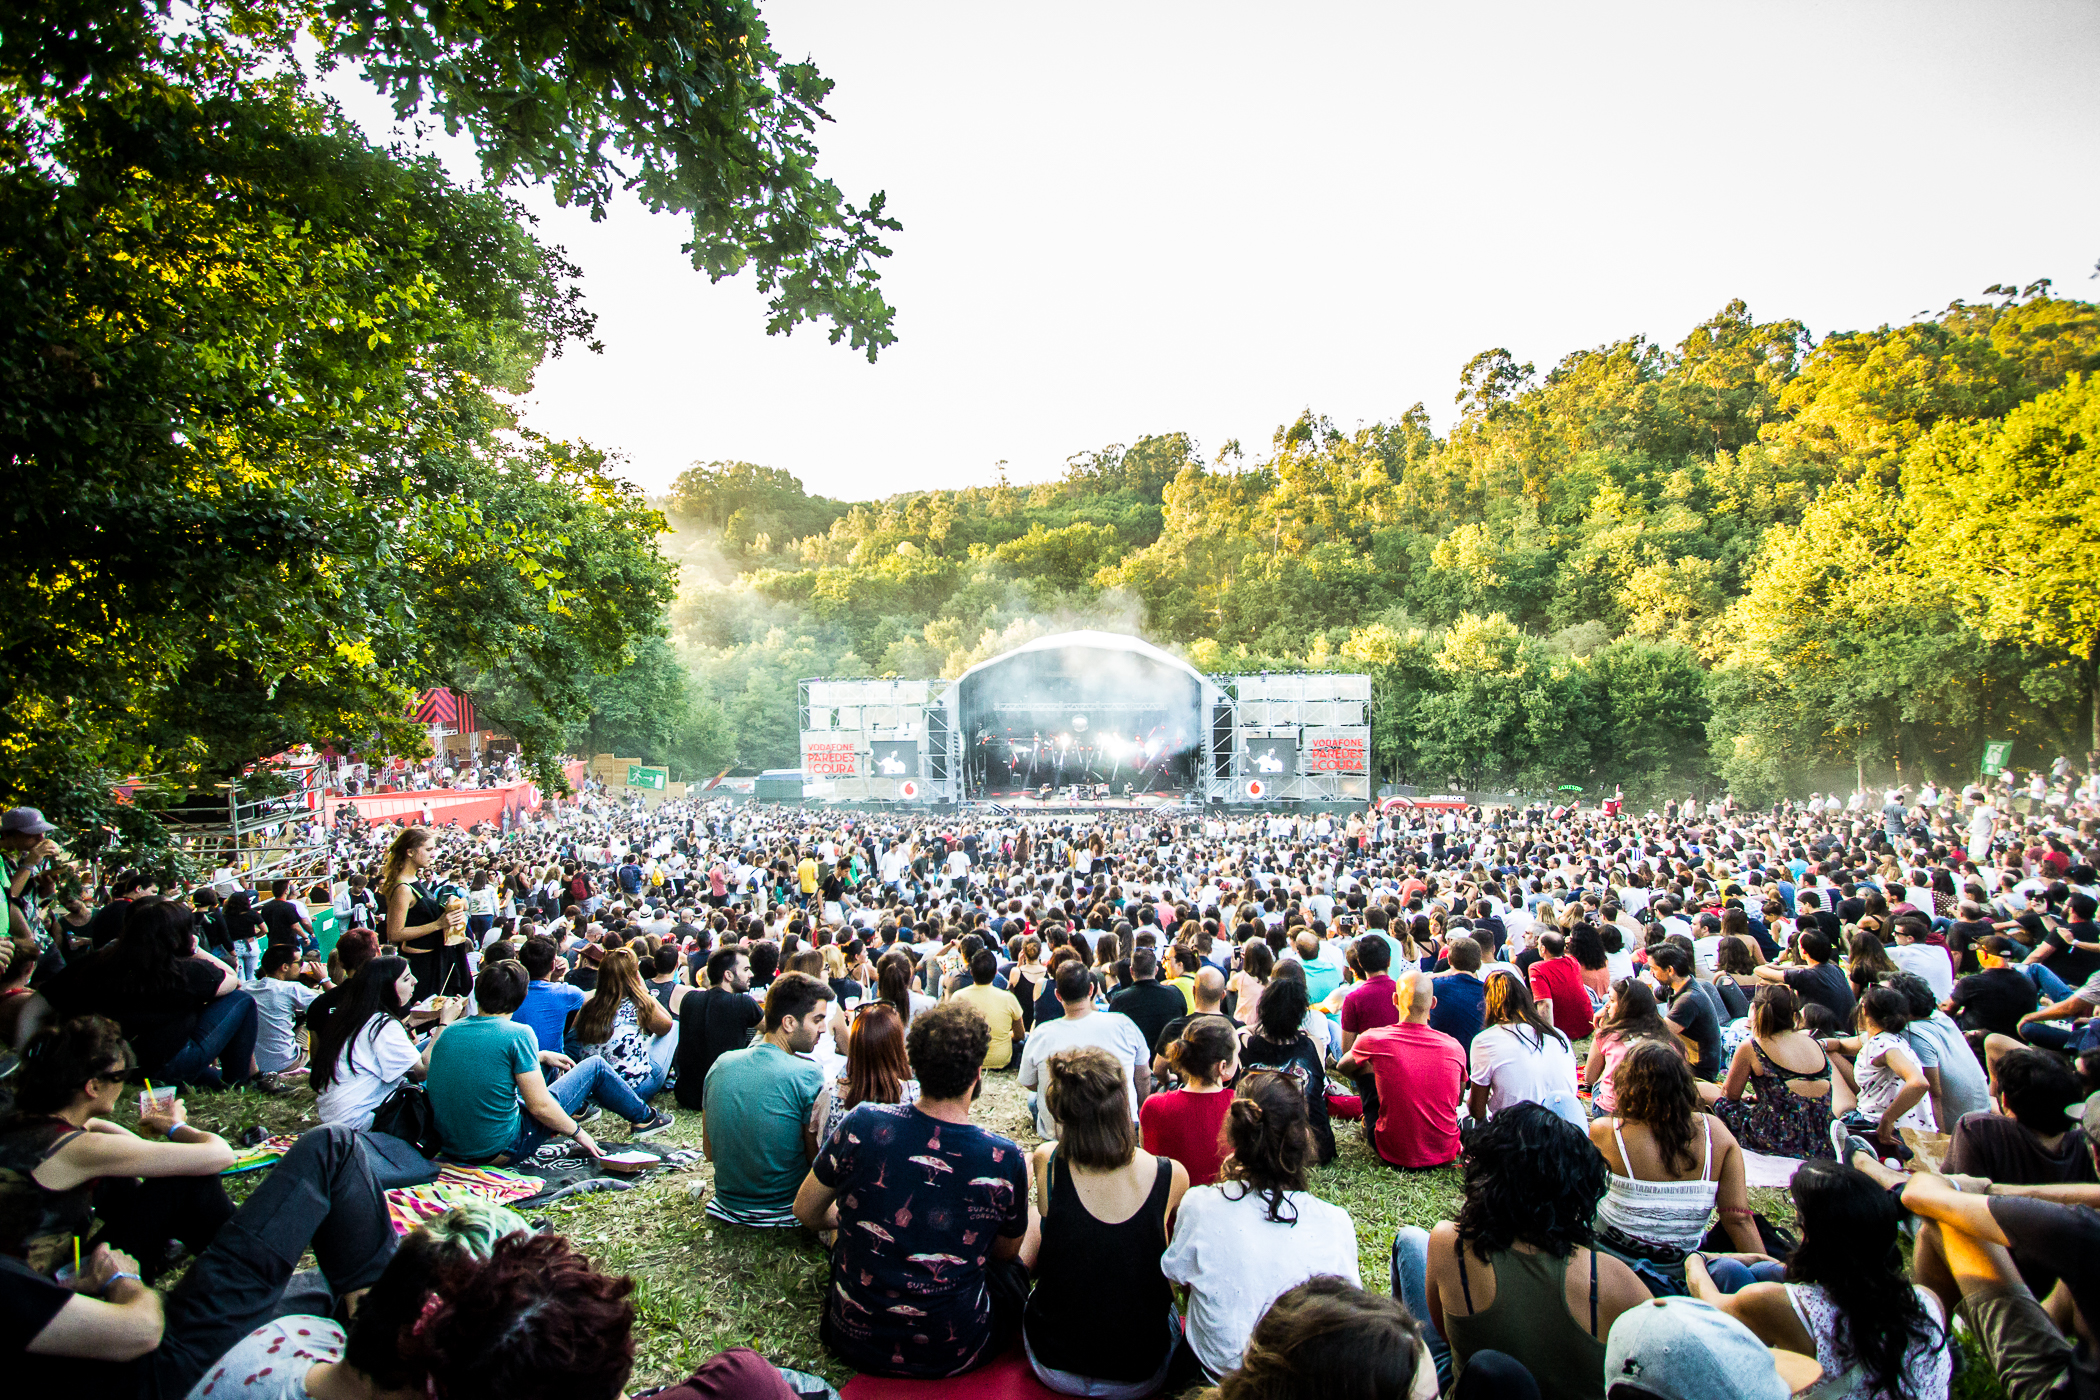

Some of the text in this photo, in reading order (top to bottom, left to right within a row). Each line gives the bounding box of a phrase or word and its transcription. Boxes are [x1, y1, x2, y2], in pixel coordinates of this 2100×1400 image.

[1312, 739, 1363, 747] VODAFONE
[808, 752, 854, 762] PAREDES
[1312, 748, 1363, 759] PAREDES
[813, 763, 855, 773] COURA
[1318, 760, 1363, 770] COURA
